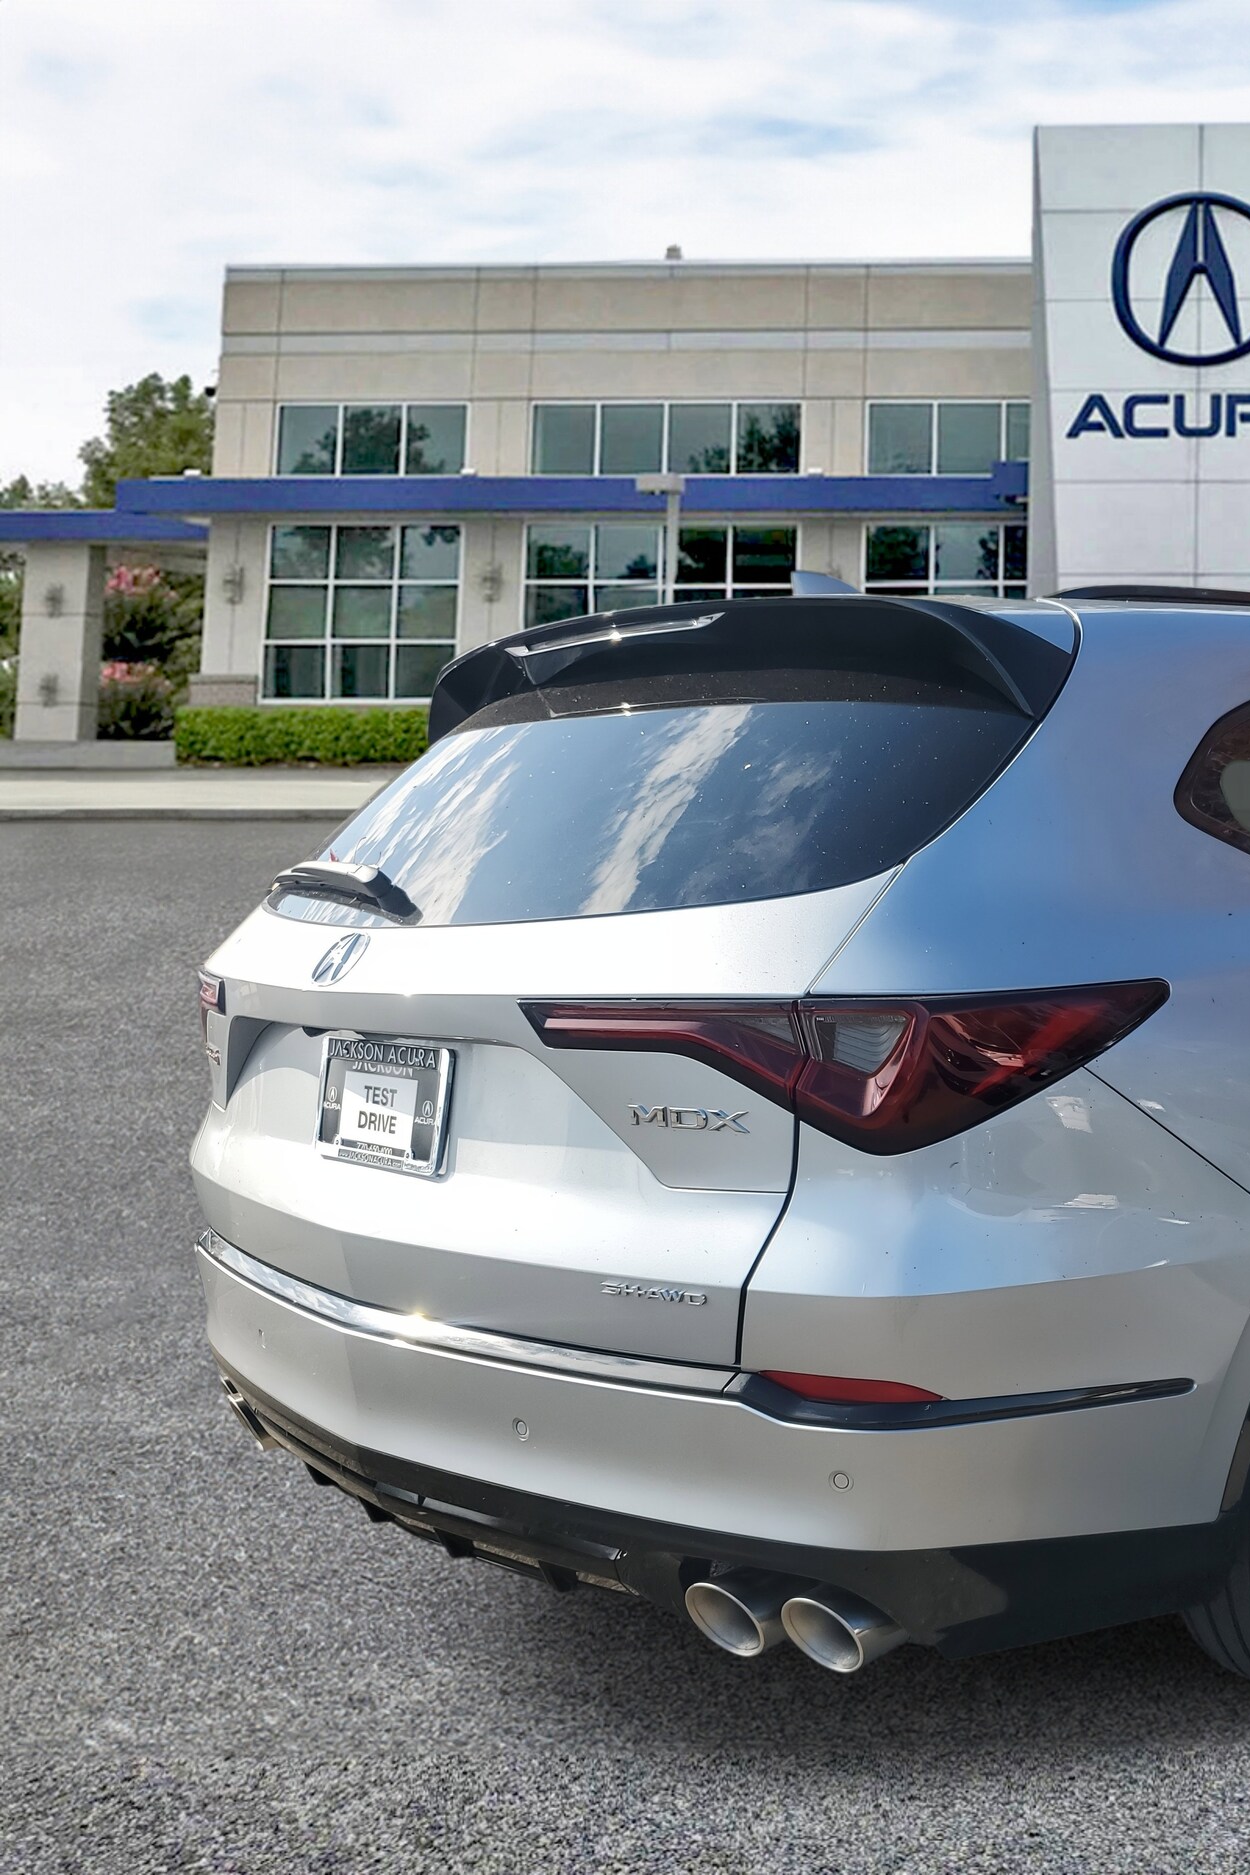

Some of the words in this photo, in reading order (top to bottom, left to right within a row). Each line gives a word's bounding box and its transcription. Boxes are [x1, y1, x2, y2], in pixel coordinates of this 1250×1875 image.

[330, 1039, 384, 1061] JACKSON
[387, 1045, 437, 1068] ACURA
[364, 1085, 397, 1107] TEST
[358, 1110, 397, 1134] DRIVE
[626, 1103, 751, 1134] MDX
